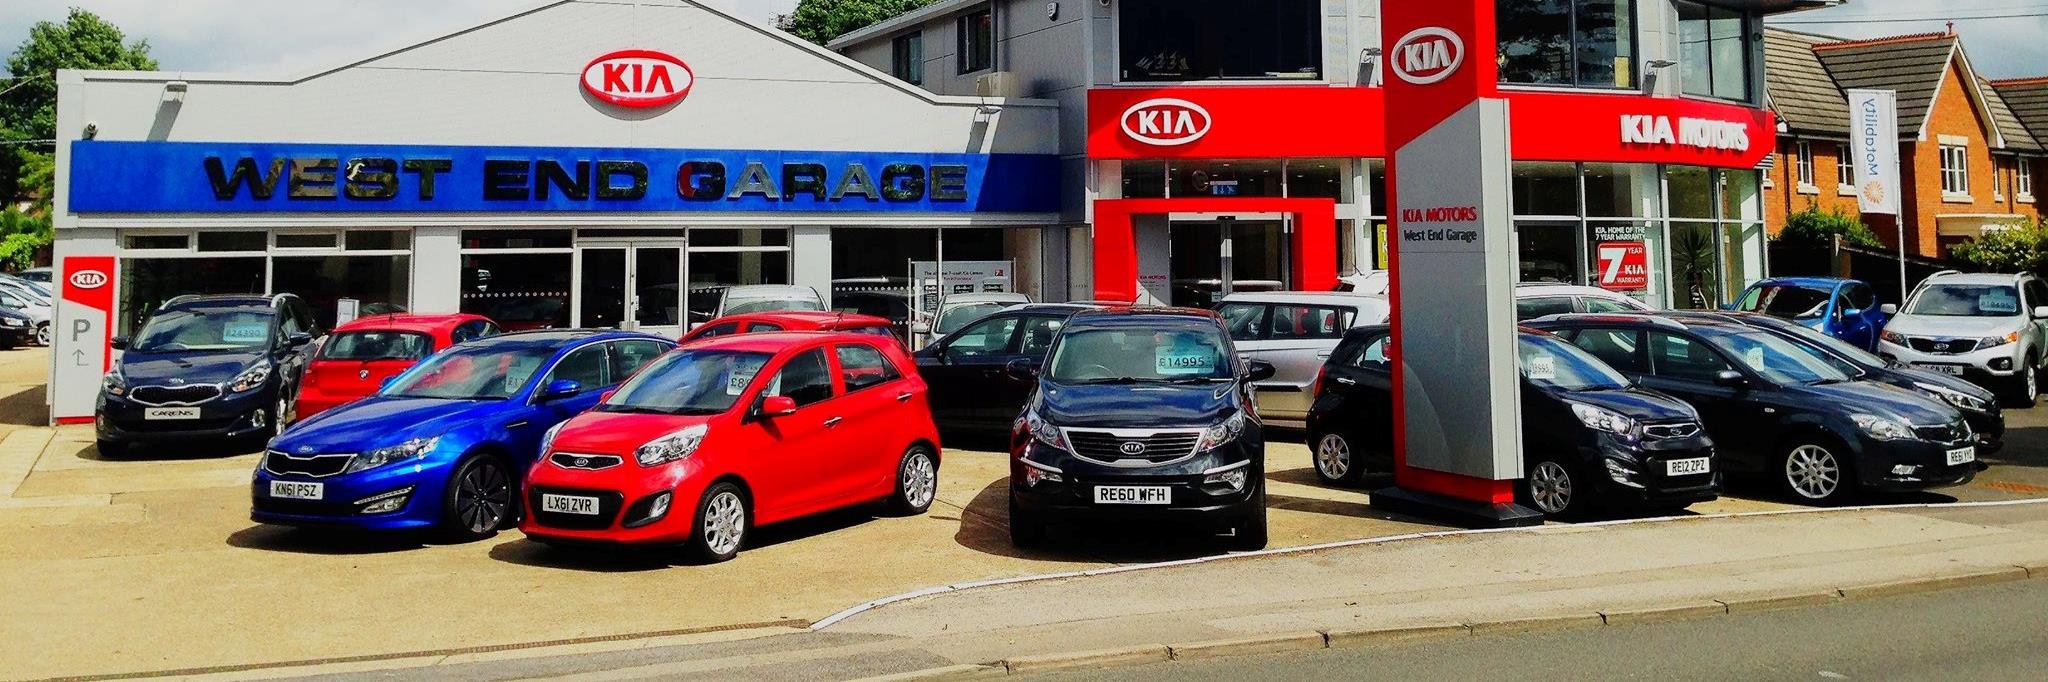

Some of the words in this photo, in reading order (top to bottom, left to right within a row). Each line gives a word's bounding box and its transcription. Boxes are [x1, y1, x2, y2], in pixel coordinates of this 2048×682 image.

[1404, 39, 1452, 72] KIA
[603, 63, 674, 93] KIA
[1138, 110, 1197, 134] KIA
[1620, 114, 1675, 144] KIA
[1678, 117, 1749, 152] MOTORS
[203, 156, 452, 200] WEST
[484, 159, 648, 201] END
[676, 160, 968, 202] GARAGE
[1403, 208, 1423, 222] KIA
[1426, 206, 1477, 222] MOTORS
[1404, 229, 1425, 241] West
[1427, 229, 1443, 241] End
[1446, 229, 1477, 243] Garage
[1608, 226, 1625, 234] HOME
[1626, 226, 1633, 234] OF
[1600, 247, 1627, 283] 7
[1624, 264, 1645, 275] KIA
[76, 273, 101, 285] KIA
[73, 319, 91, 341] P
[1672, 460, 1690, 473] RE12
[1691, 459, 1705, 471] ZPZ
[275, 482, 295, 496] KN61
[297, 483, 316, 497] PSZ
[1100, 487, 1135, 501] RE60
[1139, 488, 1166, 501] WFH
[548, 496, 570, 511] LX61
[571, 498, 592, 512] ZVR
